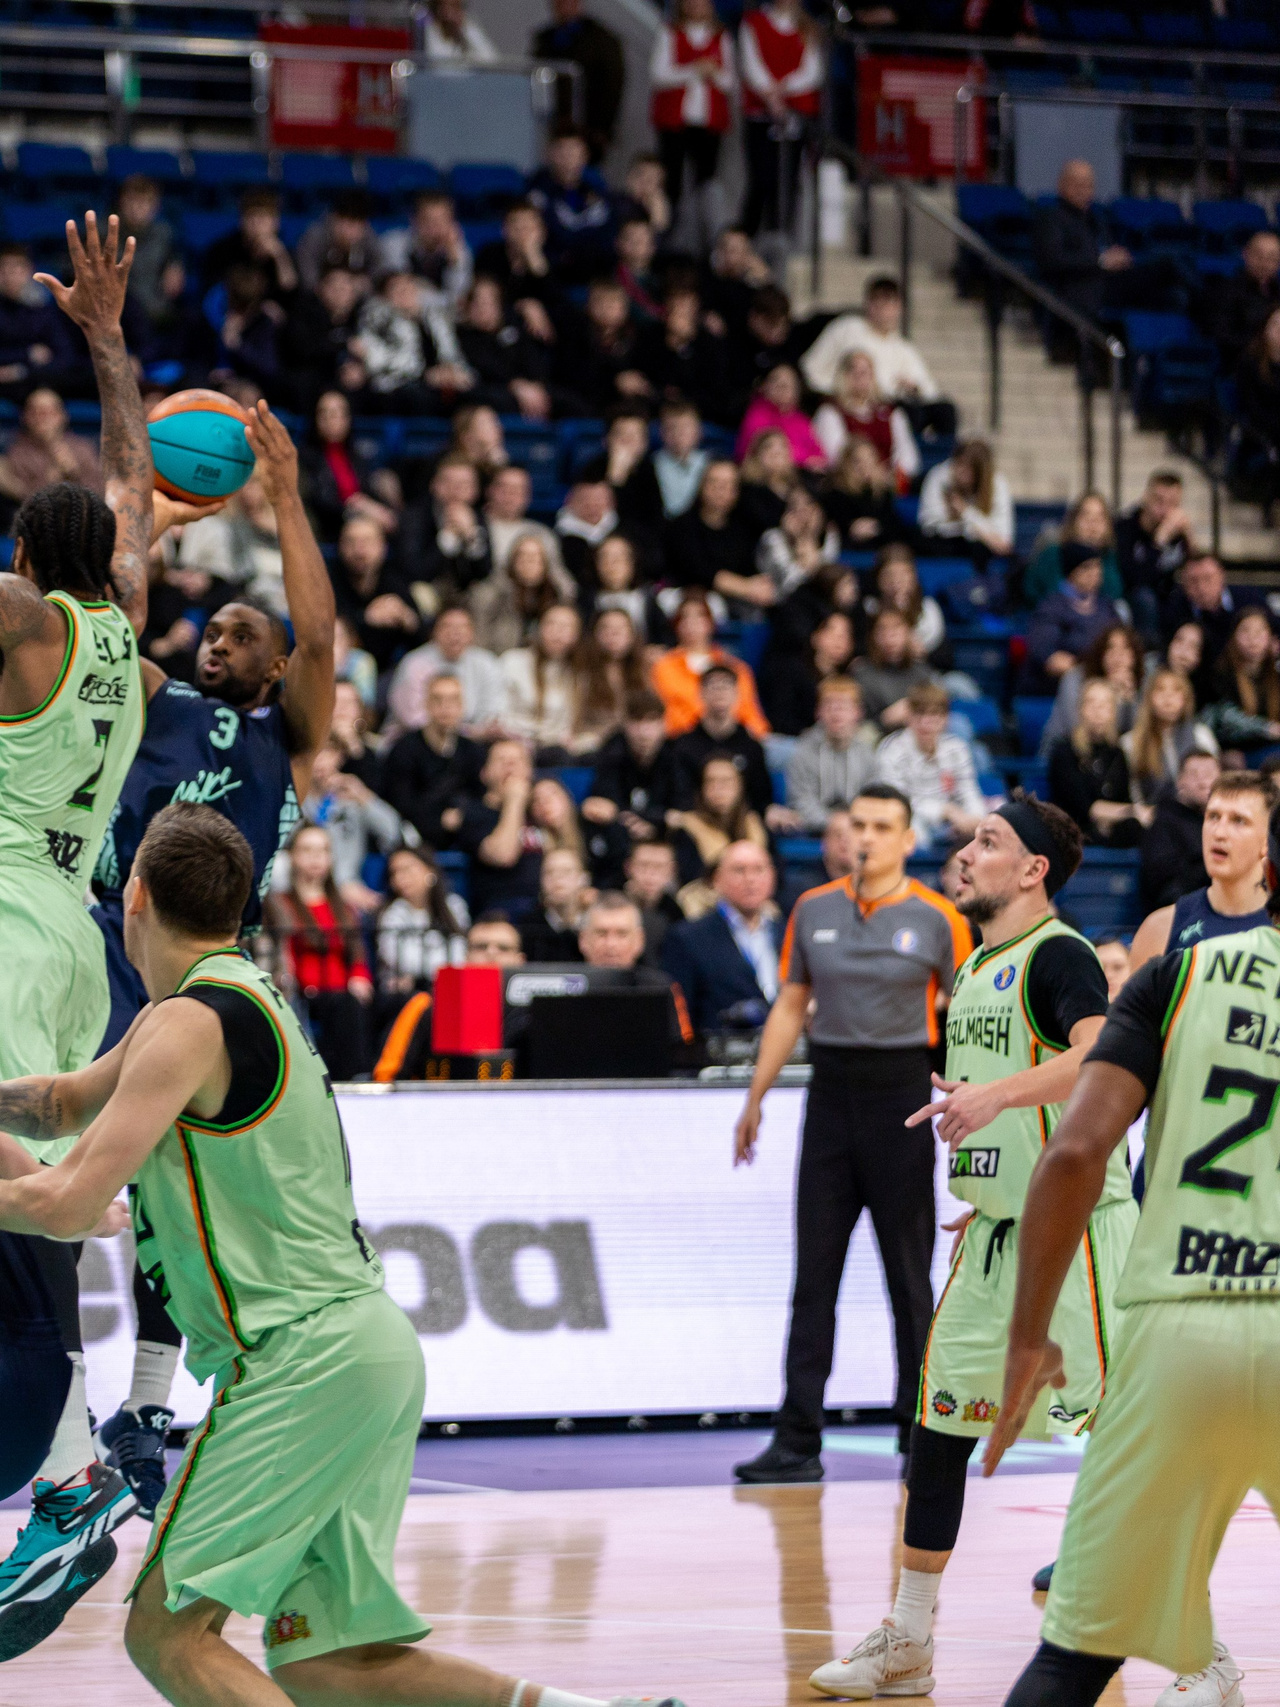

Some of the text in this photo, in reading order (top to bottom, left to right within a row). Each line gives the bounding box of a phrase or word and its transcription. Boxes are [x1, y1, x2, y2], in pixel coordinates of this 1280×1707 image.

[66, 718, 115, 813] 2
[208, 707, 240, 751] 3
[1204, 949, 1280, 1000] NE
[1177, 1064, 1280, 1201] 2
